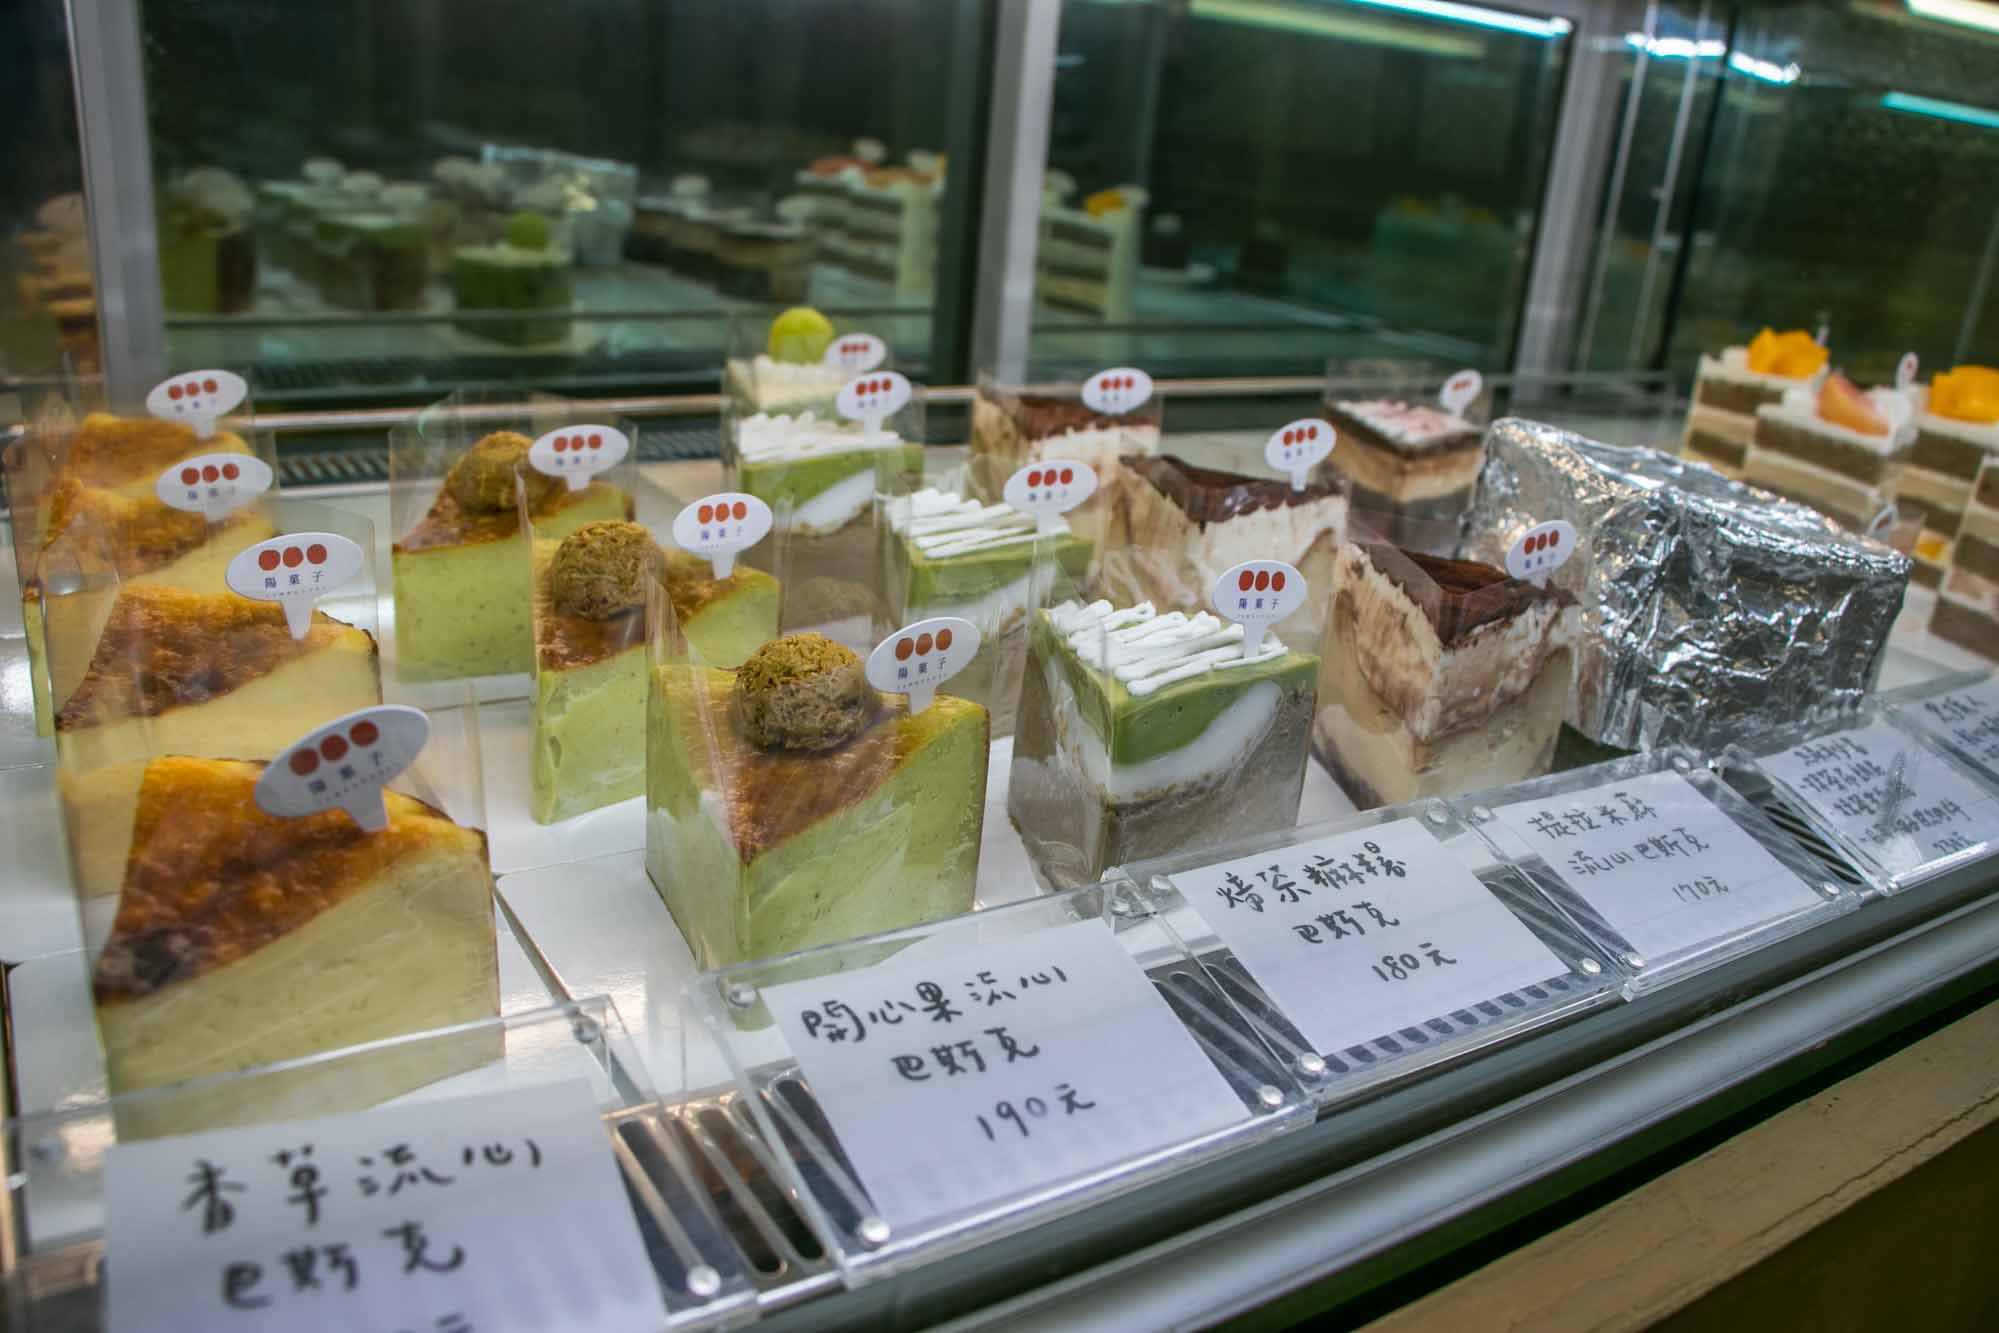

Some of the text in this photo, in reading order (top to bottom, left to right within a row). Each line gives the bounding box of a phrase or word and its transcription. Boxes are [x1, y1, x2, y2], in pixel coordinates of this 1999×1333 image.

[1292, 900, 1400, 945] 巴斯克
[1371, 942, 1457, 983] 180元
[890, 1026, 1040, 1082] 巴斯克
[976, 1083, 1096, 1141] 190元
[182, 1138, 542, 1235] 香草流心
[220, 1221, 467, 1310] 巴斯克
